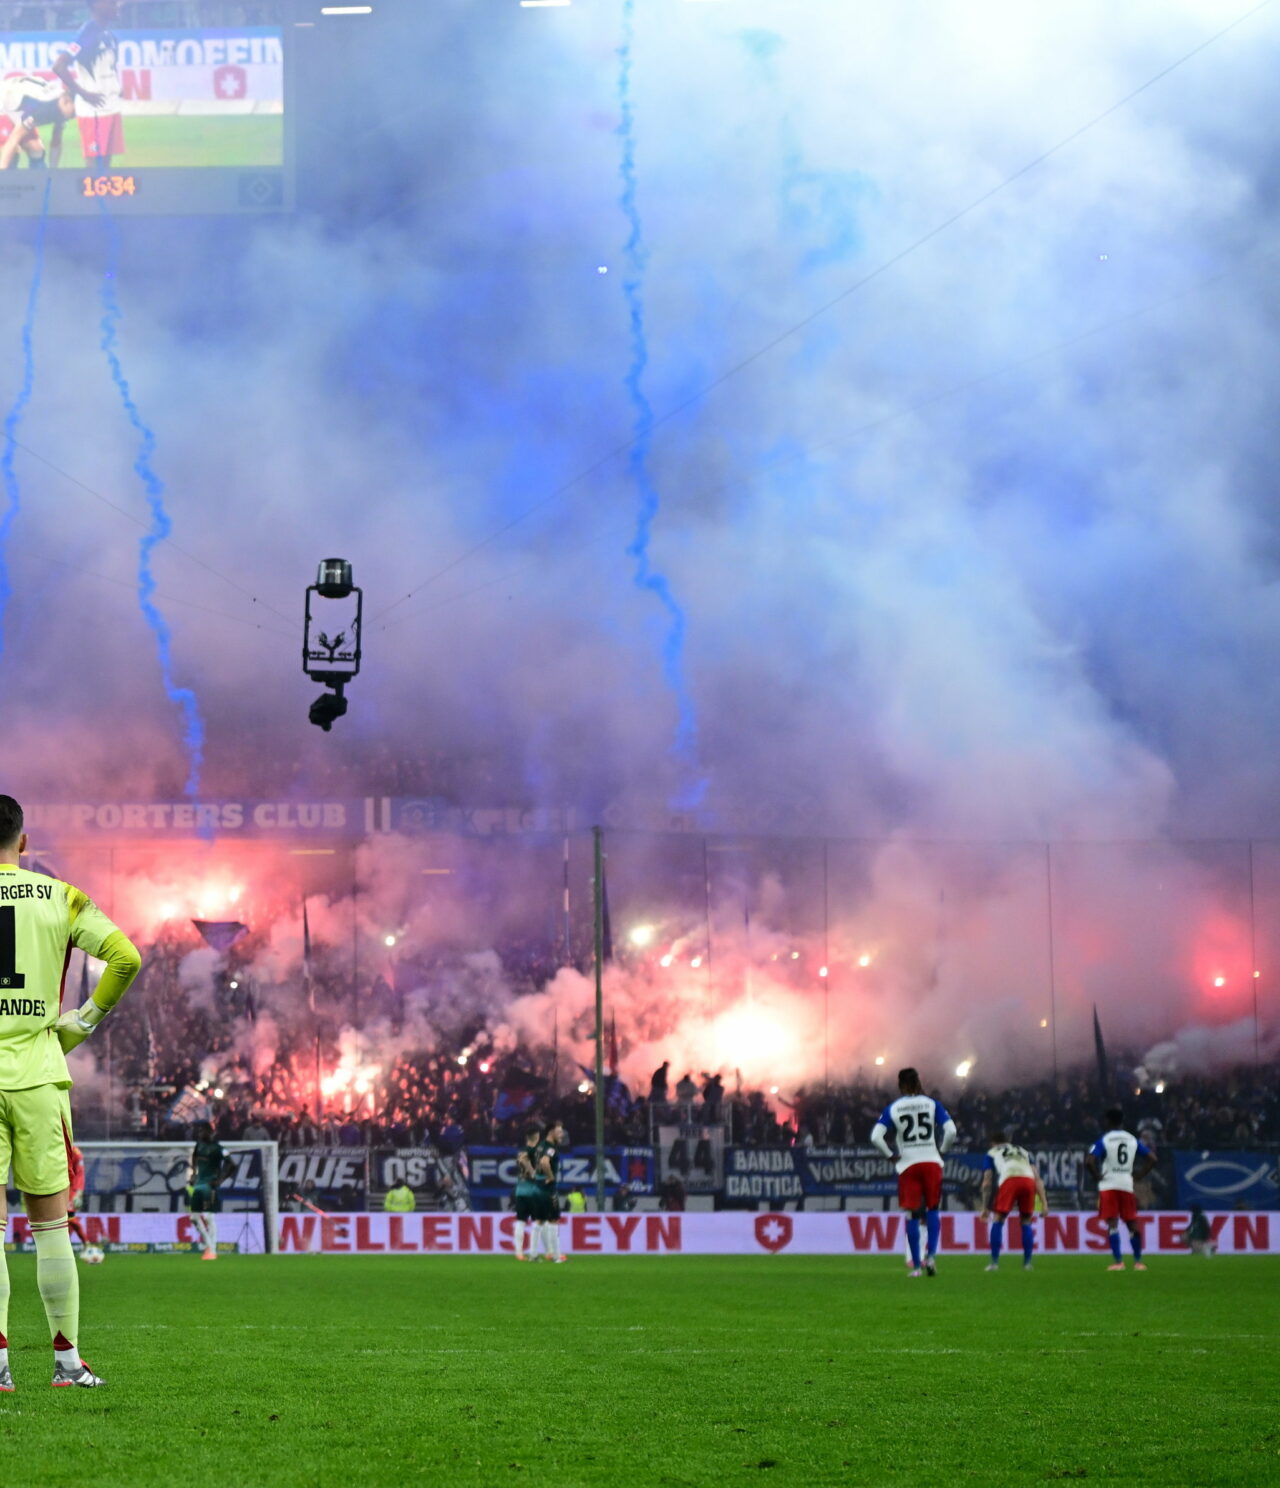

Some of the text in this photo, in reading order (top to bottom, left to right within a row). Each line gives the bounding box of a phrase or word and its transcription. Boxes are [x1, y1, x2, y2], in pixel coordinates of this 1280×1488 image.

[82, 176, 136, 198] 16:34
[254, 803, 347, 829] CLUB
[37, 885, 53, 900] SV
[899, 1112, 932, 1142] 25
[735, 1151, 794, 1172] BANDA
[1117, 1143, 1128, 1165] 6
[472, 1159, 622, 1184] FOZA
[726, 1175, 803, 1198] CAOTICA
